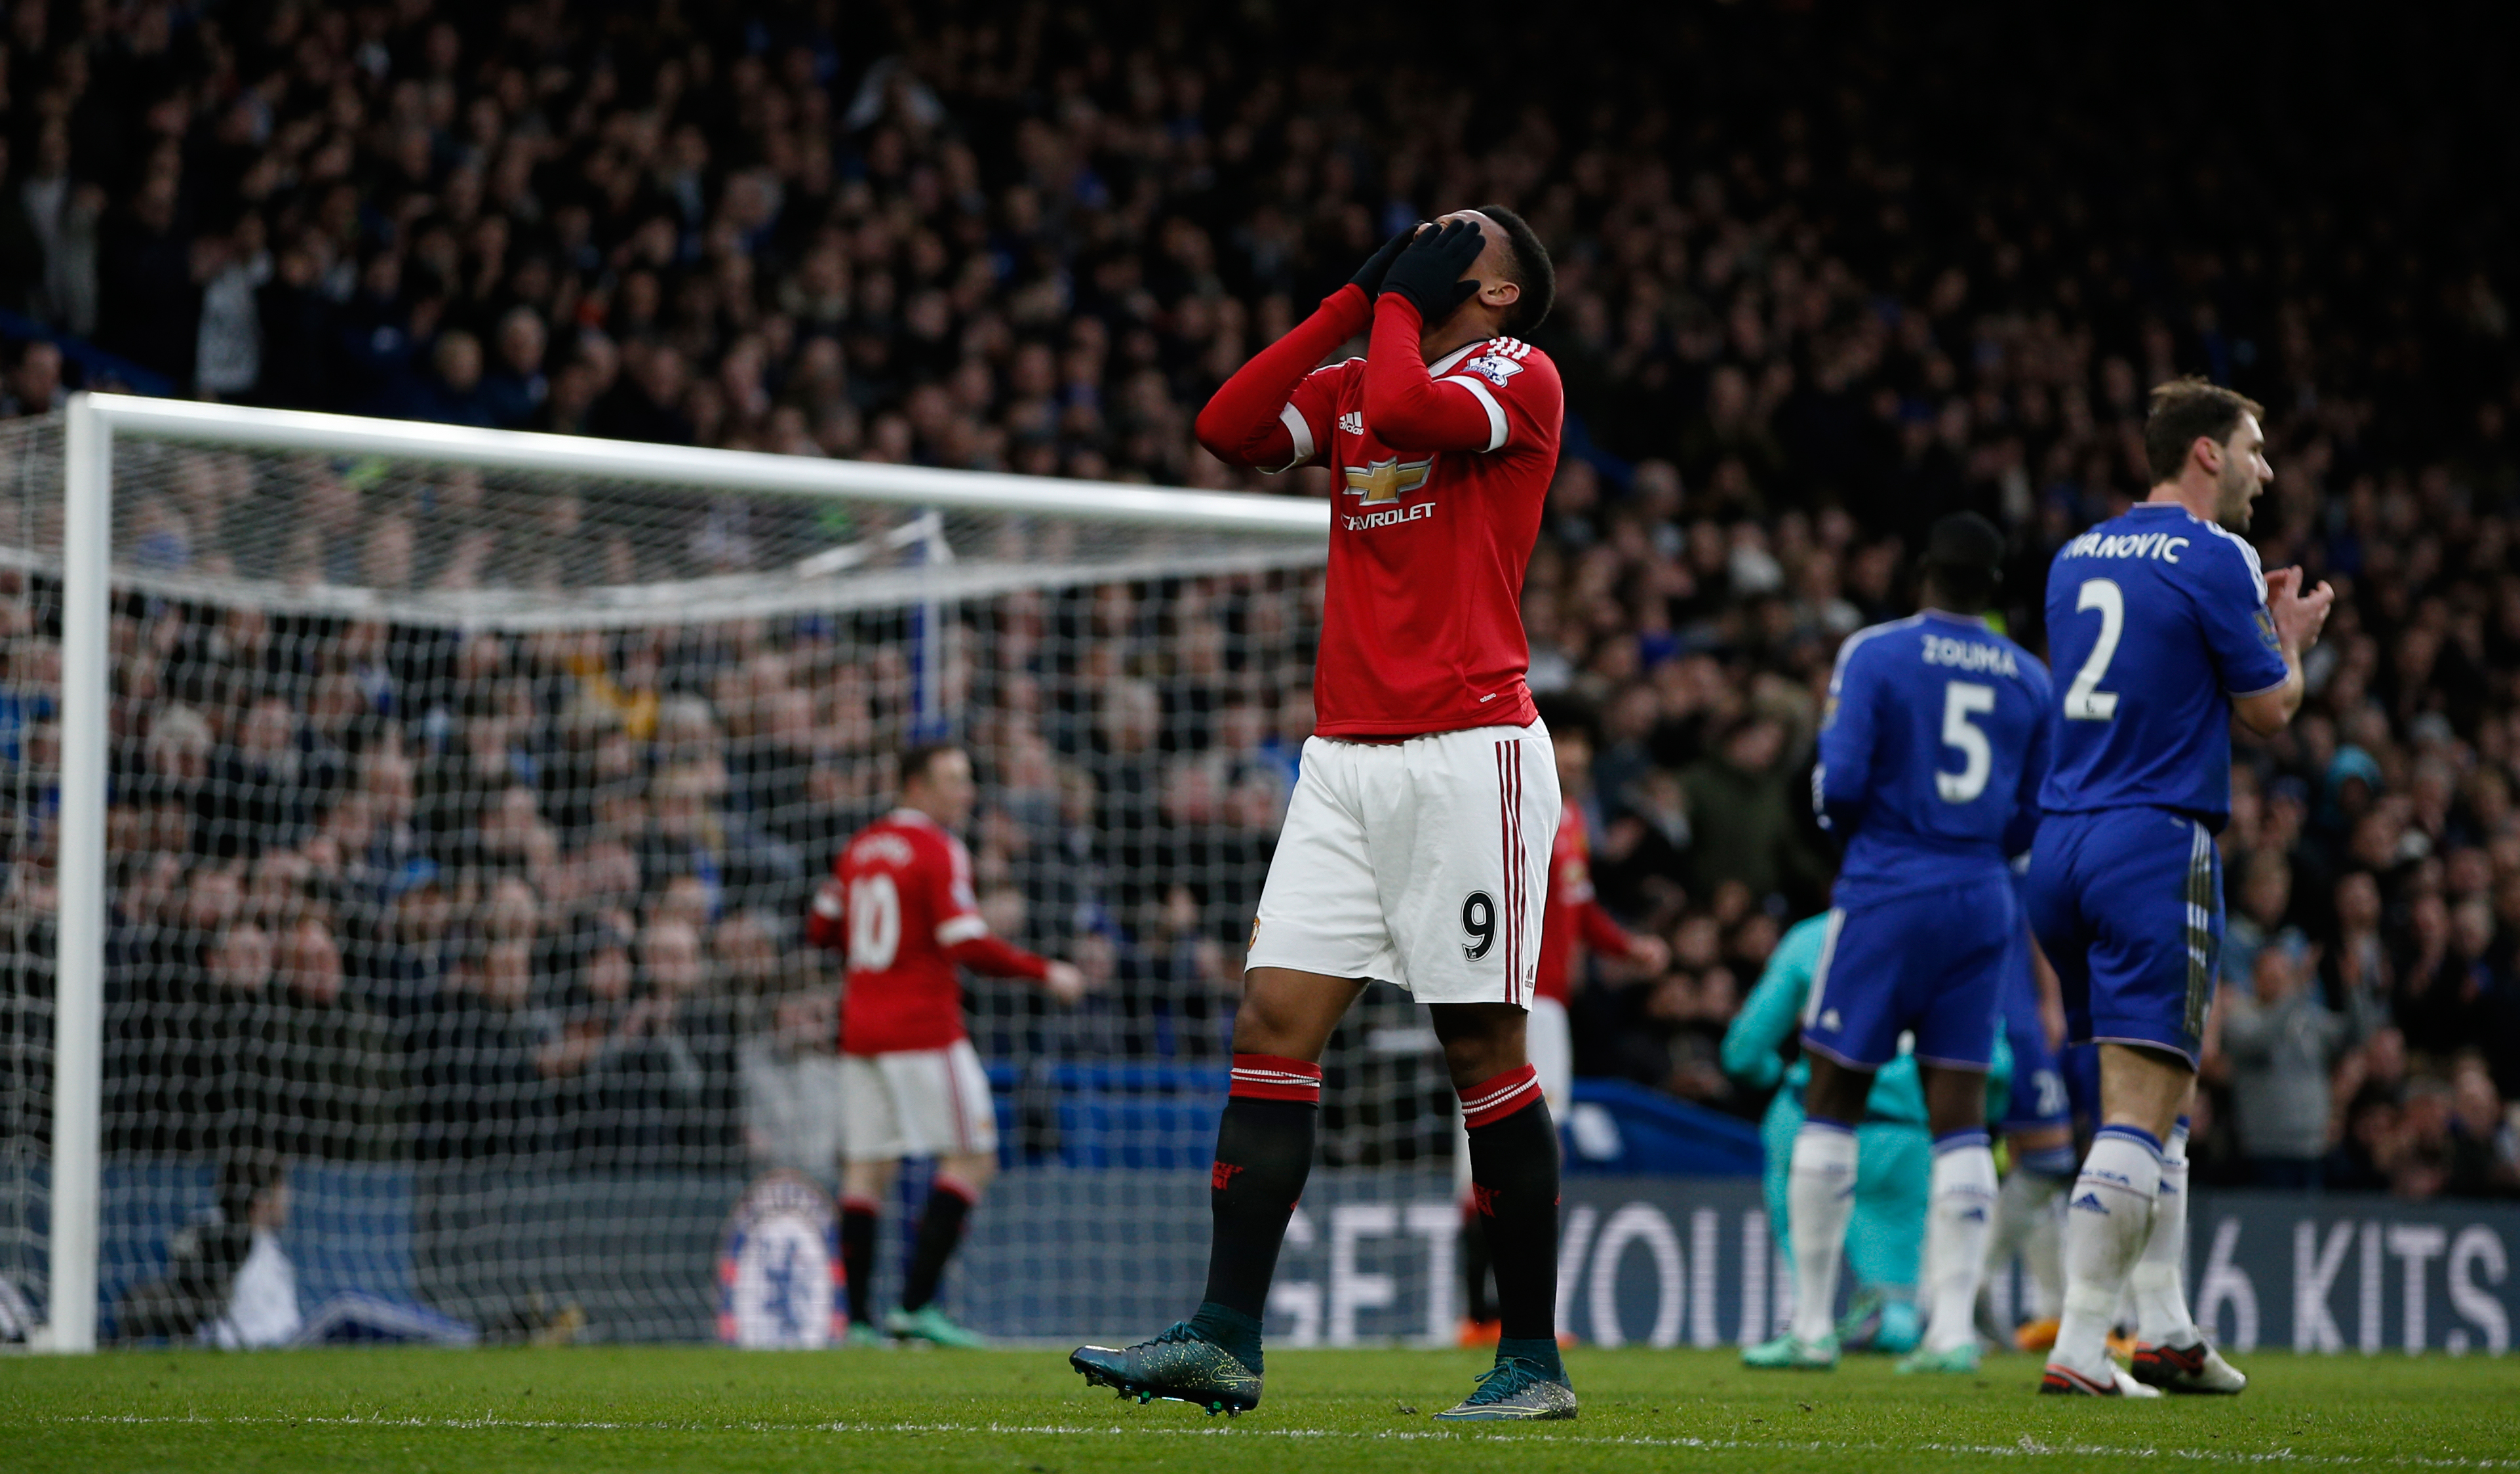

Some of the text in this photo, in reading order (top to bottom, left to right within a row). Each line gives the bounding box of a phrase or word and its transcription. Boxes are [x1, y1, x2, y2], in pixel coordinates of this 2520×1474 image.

[1339, 420, 1364, 435] didas
[1921, 633, 2019, 679] ZOUMA
[2064, 578, 2123, 721] 2
[1934, 681, 1996, 804] 5
[849, 873, 901, 972] 10
[1461, 890, 1498, 961] 9
[1555, 1201, 1795, 1348] YOU
[2294, 1221, 2510, 1357] KITS
